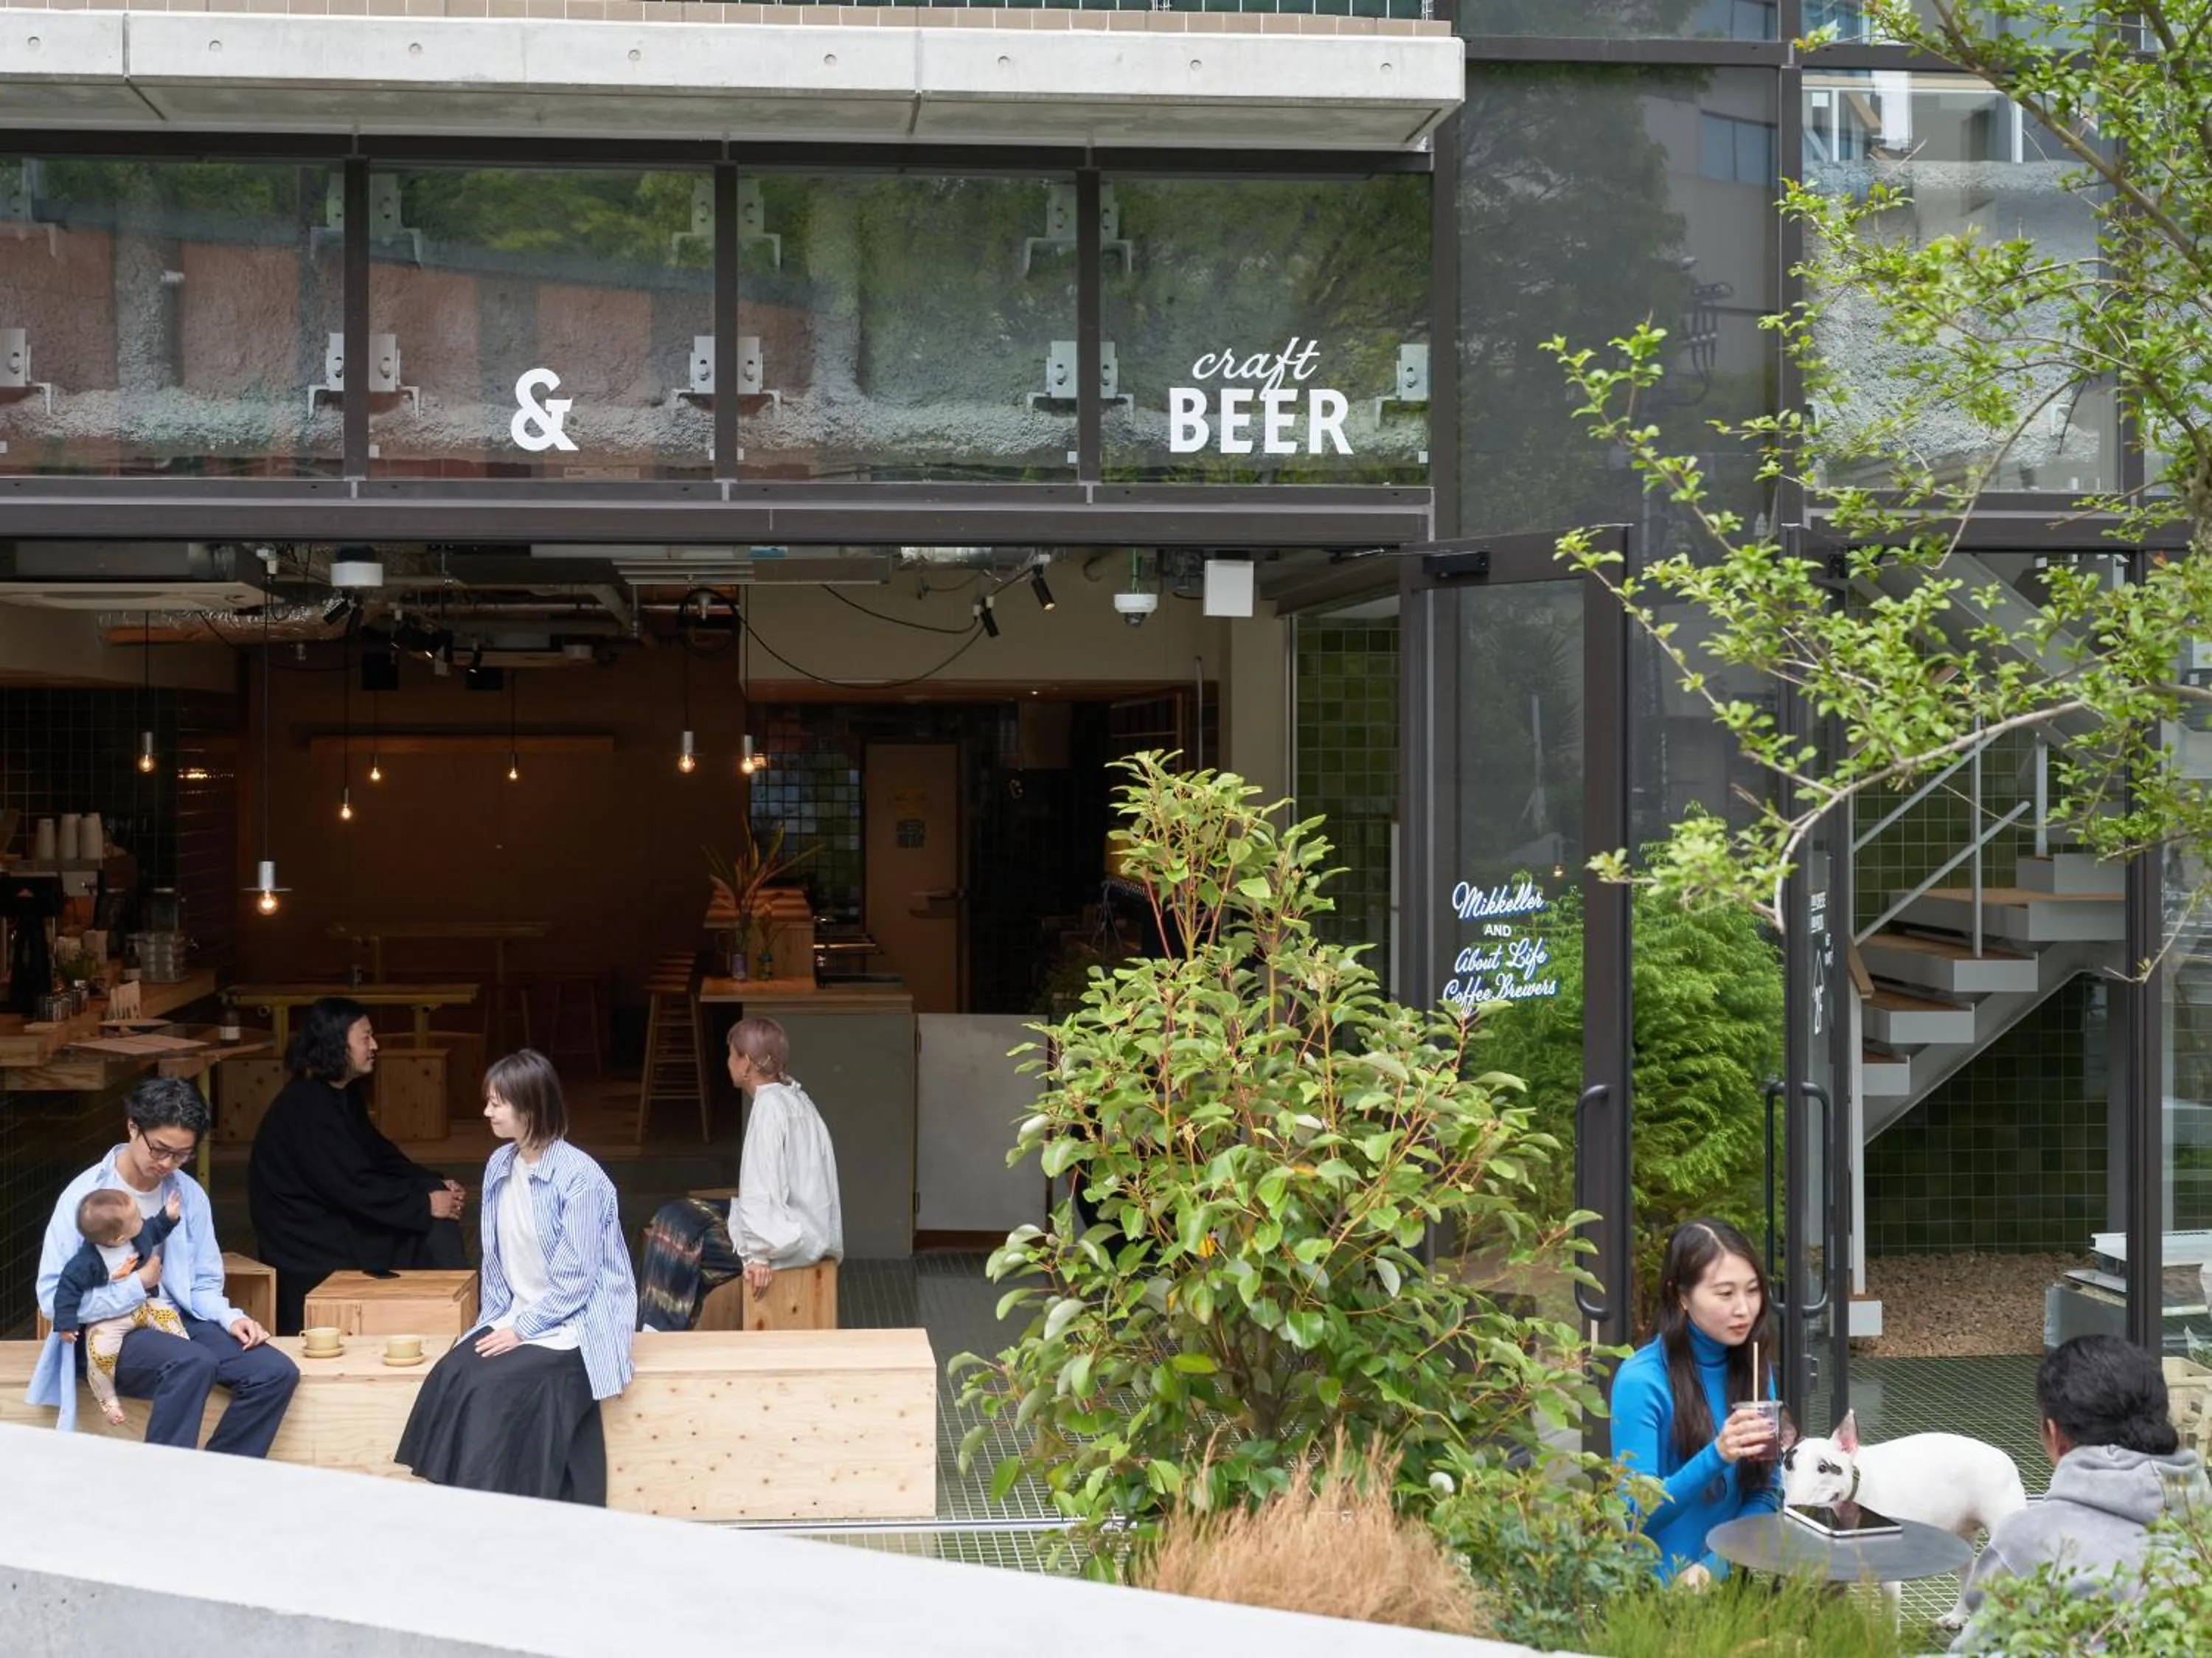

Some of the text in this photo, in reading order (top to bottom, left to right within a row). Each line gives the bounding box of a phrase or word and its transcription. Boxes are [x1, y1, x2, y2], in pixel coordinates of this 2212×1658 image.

[1192, 336, 1321, 401] craft
[510, 367, 580, 451] &
[1169, 387, 1354, 455] BEER
[1451, 881, 1546, 919] Mikkeller
[1484, 923, 1512, 937] AND
[1454, 937, 1548, 980] About Life
[1442, 972, 1557, 1015] Coffee Brewers
